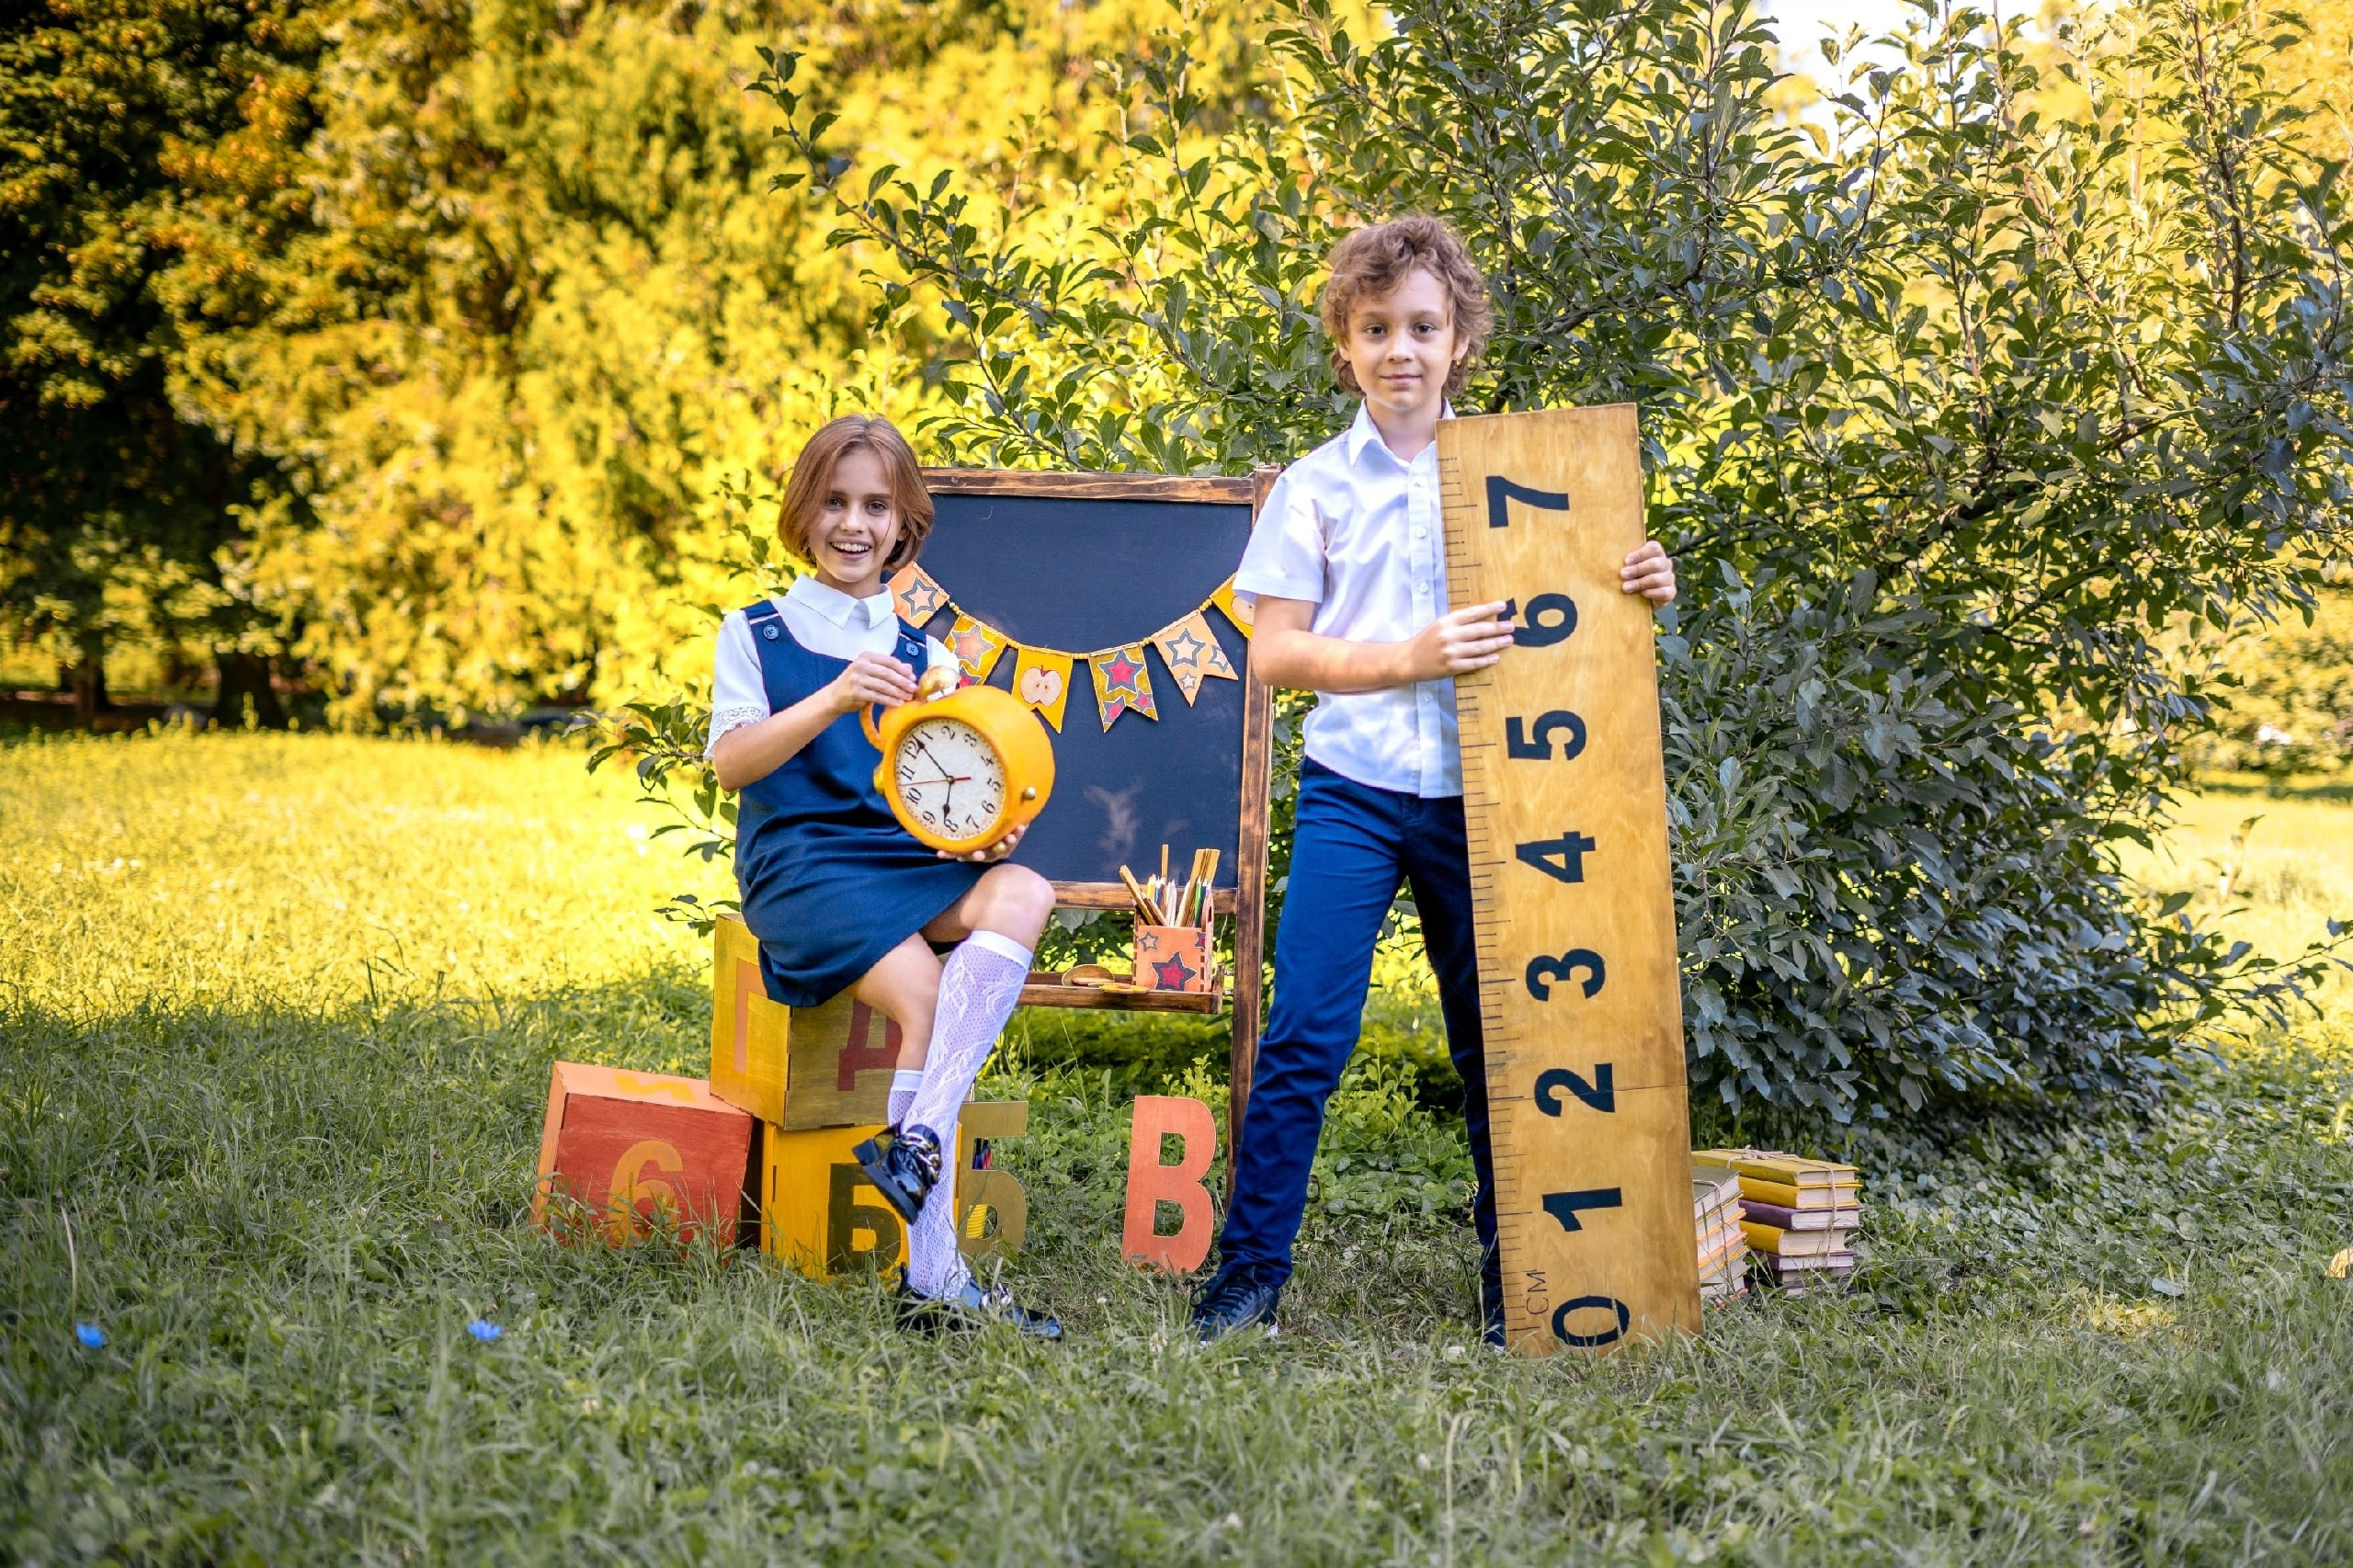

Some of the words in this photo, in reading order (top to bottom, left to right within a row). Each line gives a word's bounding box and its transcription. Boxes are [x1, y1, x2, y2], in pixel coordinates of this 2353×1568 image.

[1485, 474, 1570, 528] 7
[1495, 593, 1578, 648] 6
[920, 729, 934, 743] 1
[940, 724, 956, 741] 2
[963, 733, 977, 748] 3
[1506, 710, 1587, 761] 5
[904, 739, 922, 760] 12
[979, 754, 995, 767] 4
[900, 764, 916, 781] 11
[986, 777, 1002, 793] 5
[905, 787, 923, 807] 10
[981, 800, 996, 814] 6
[922, 810, 937, 825] 9
[943, 818, 960, 834] 8
[965, 813, 981, 830] 7
[1515, 830, 1597, 883] 4
[1526, 948, 1607, 1002] 3
[1533, 1062, 1616, 1118] 2
[1541, 1187, 1623, 1233] 1
[1551, 1295, 1631, 1347] 0
